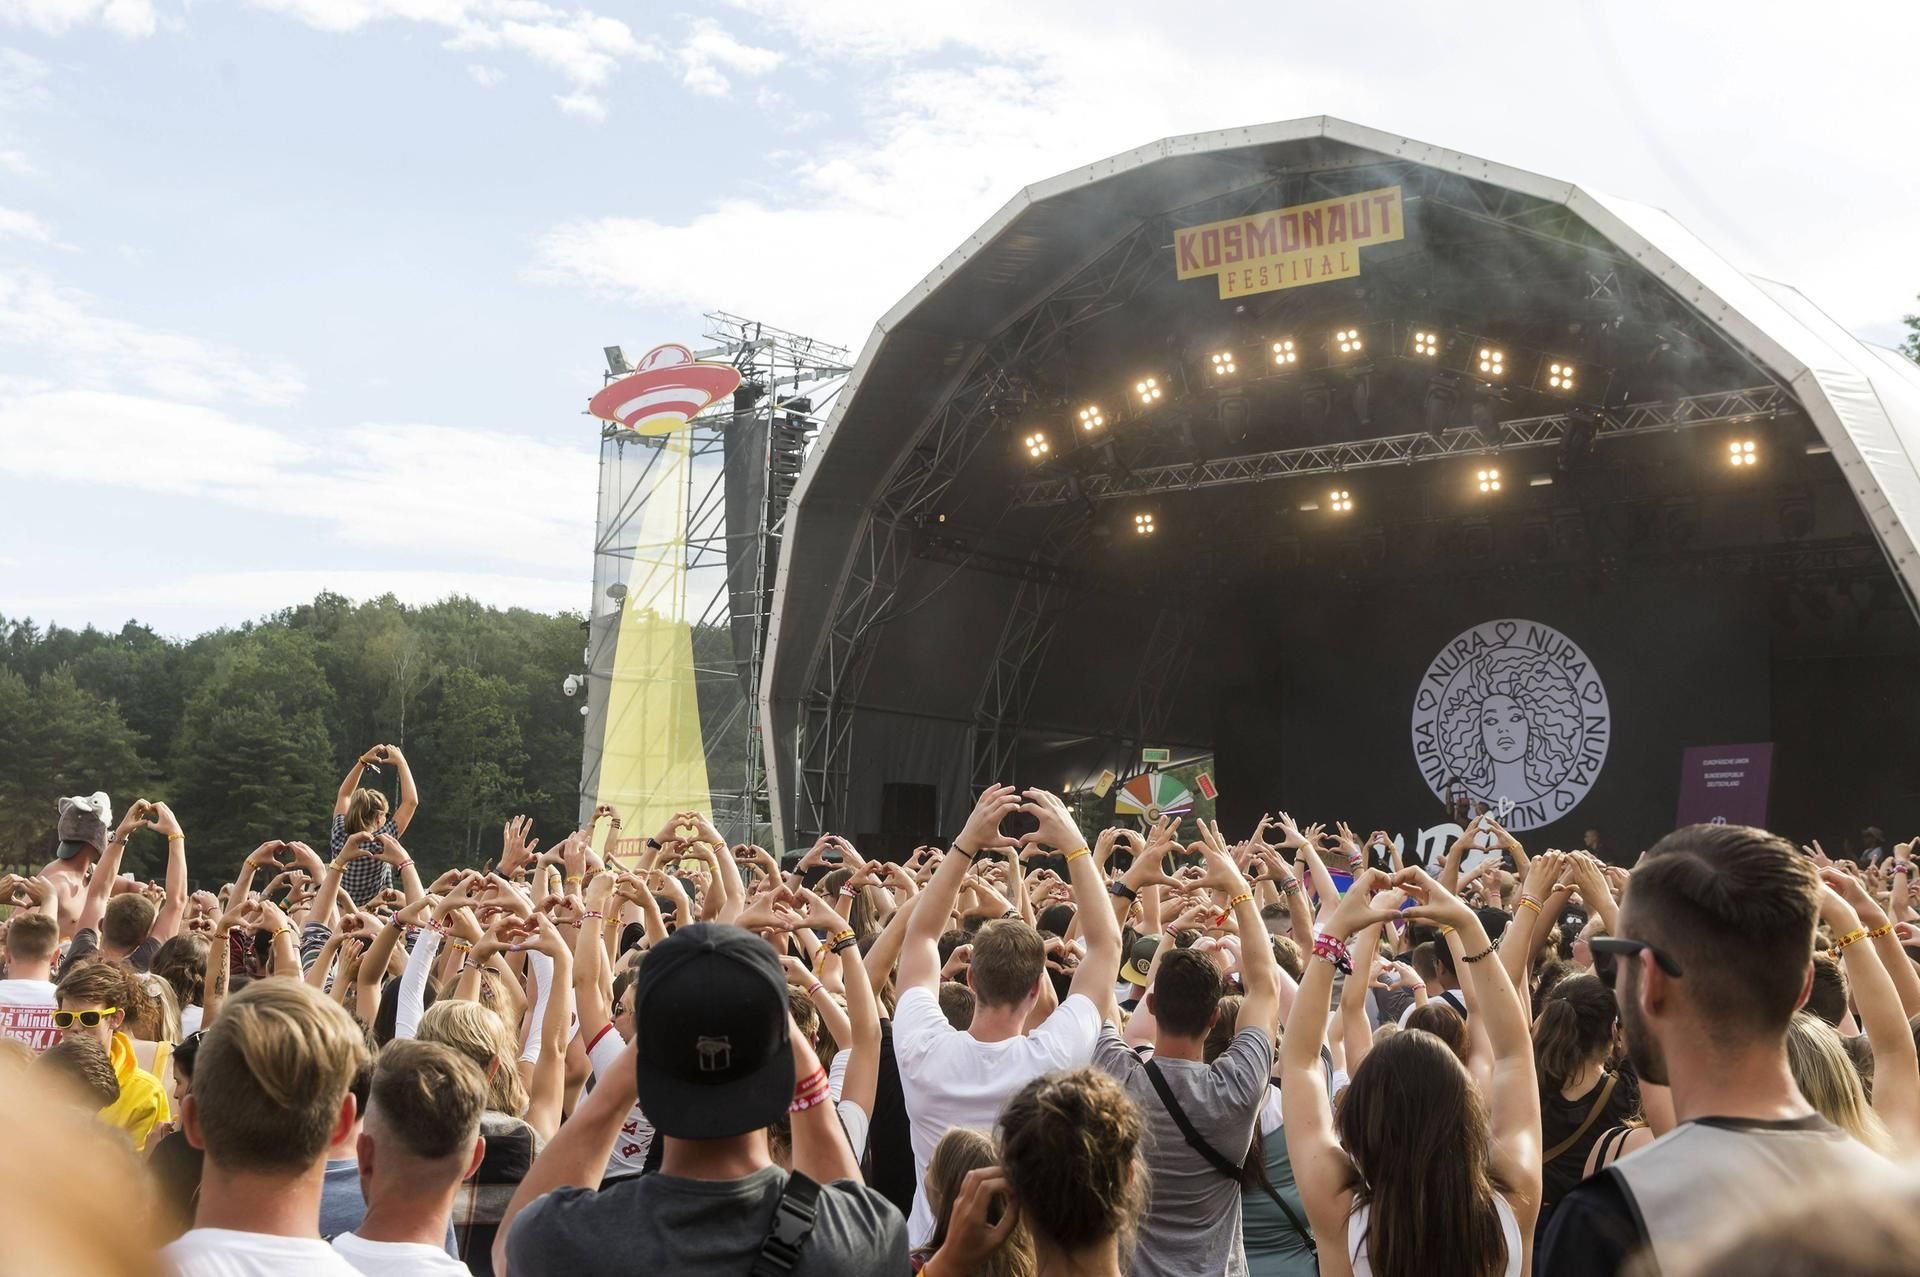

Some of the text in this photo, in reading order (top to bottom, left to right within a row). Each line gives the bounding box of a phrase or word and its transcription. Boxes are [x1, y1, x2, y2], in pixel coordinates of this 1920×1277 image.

[1179, 194, 1395, 272] KOSMONAUT
[1227, 251, 1350, 292] FESTIVAL
[1428, 631, 1489, 687] NURA
[1526, 626, 1587, 683] NURA
[1415, 720, 1450, 792] NURA
[1568, 715, 1607, 788] NURA
[17, 1013, 58, 1028] Minut
